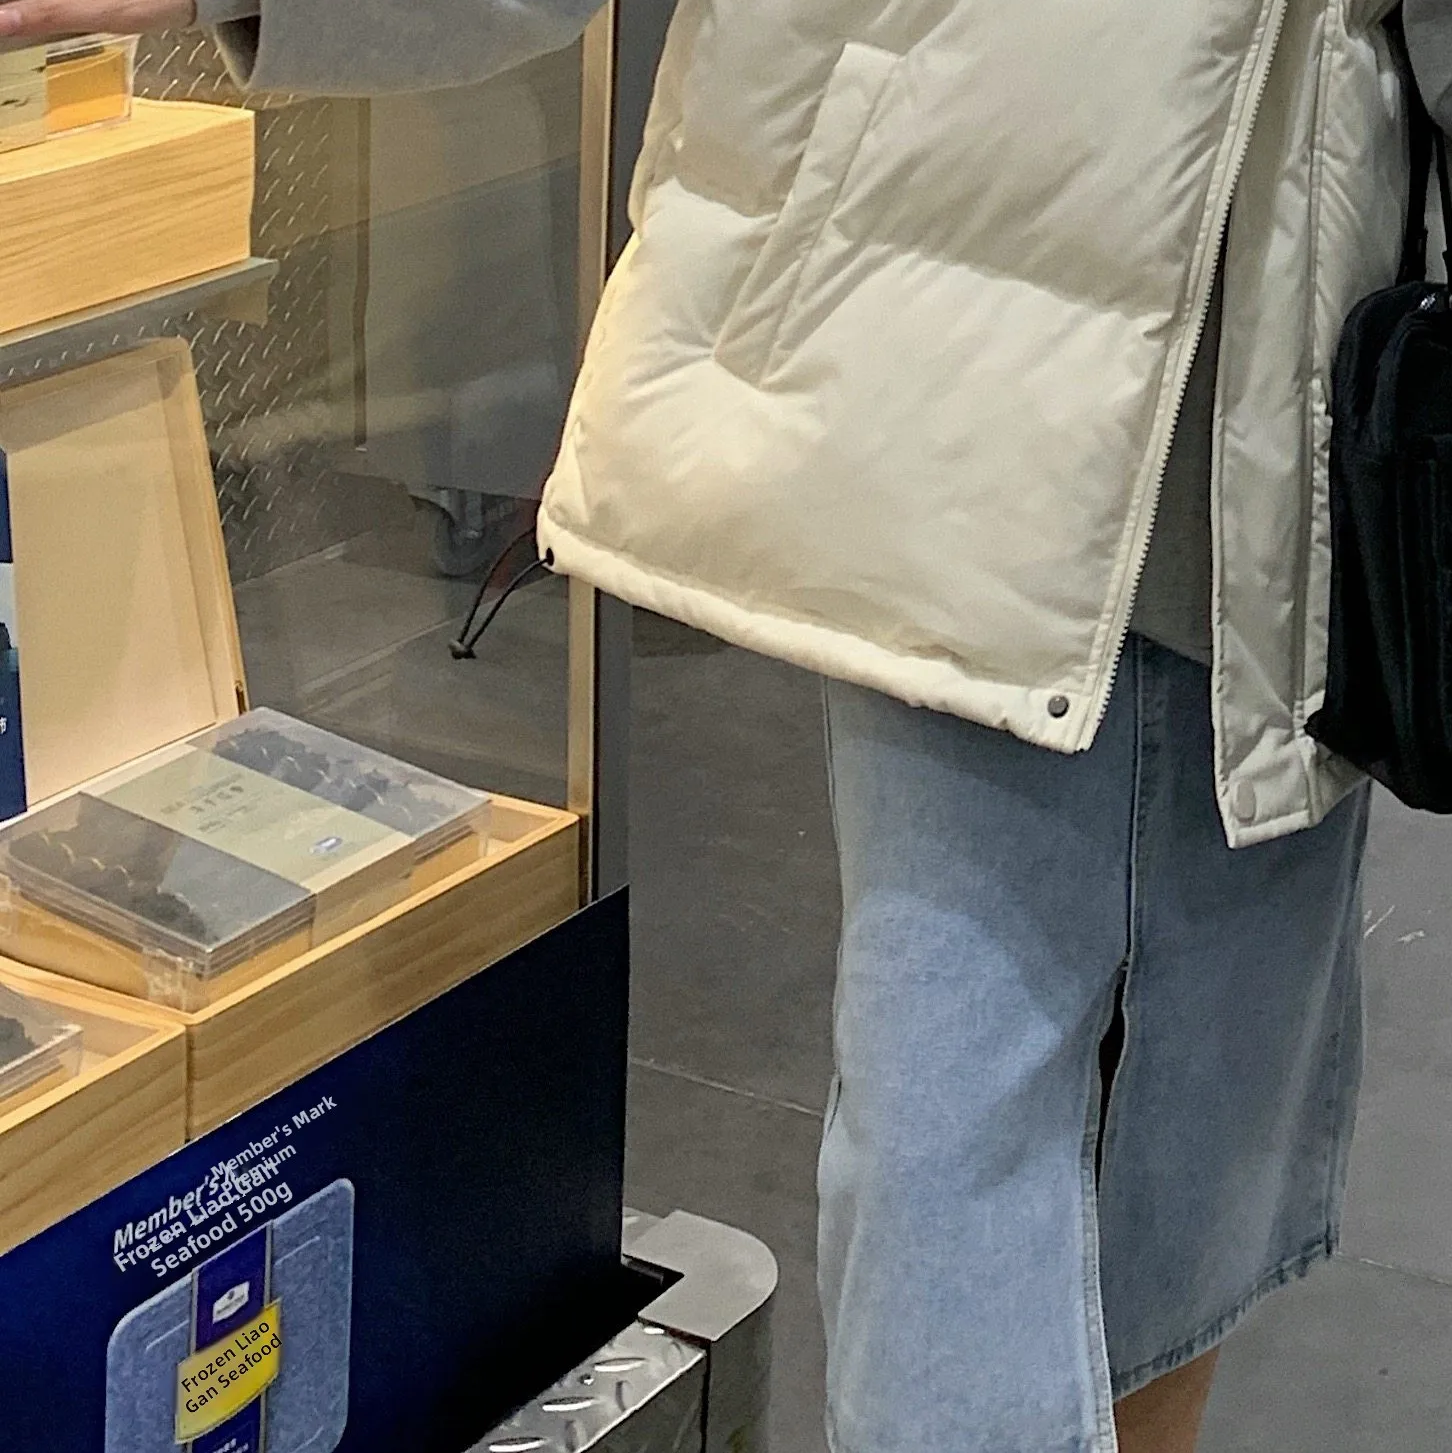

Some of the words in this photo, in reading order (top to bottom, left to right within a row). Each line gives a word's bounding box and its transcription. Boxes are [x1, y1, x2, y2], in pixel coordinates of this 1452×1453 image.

[211, 1126, 293, 1180] Member's
[292, 1094, 338, 1130] Mark
[113, 1174, 220, 1254] Member's
[113, 1220, 188, 1273] Frozen
[151, 1212, 238, 1278] Seafood
[238, 1181, 294, 1223] 500g
[181, 1348, 237, 1393] Frozen
[234, 1321, 270, 1351] Liao
[185, 1386, 219, 1413] Gan
[218, 1332, 283, 1389] Seafood
